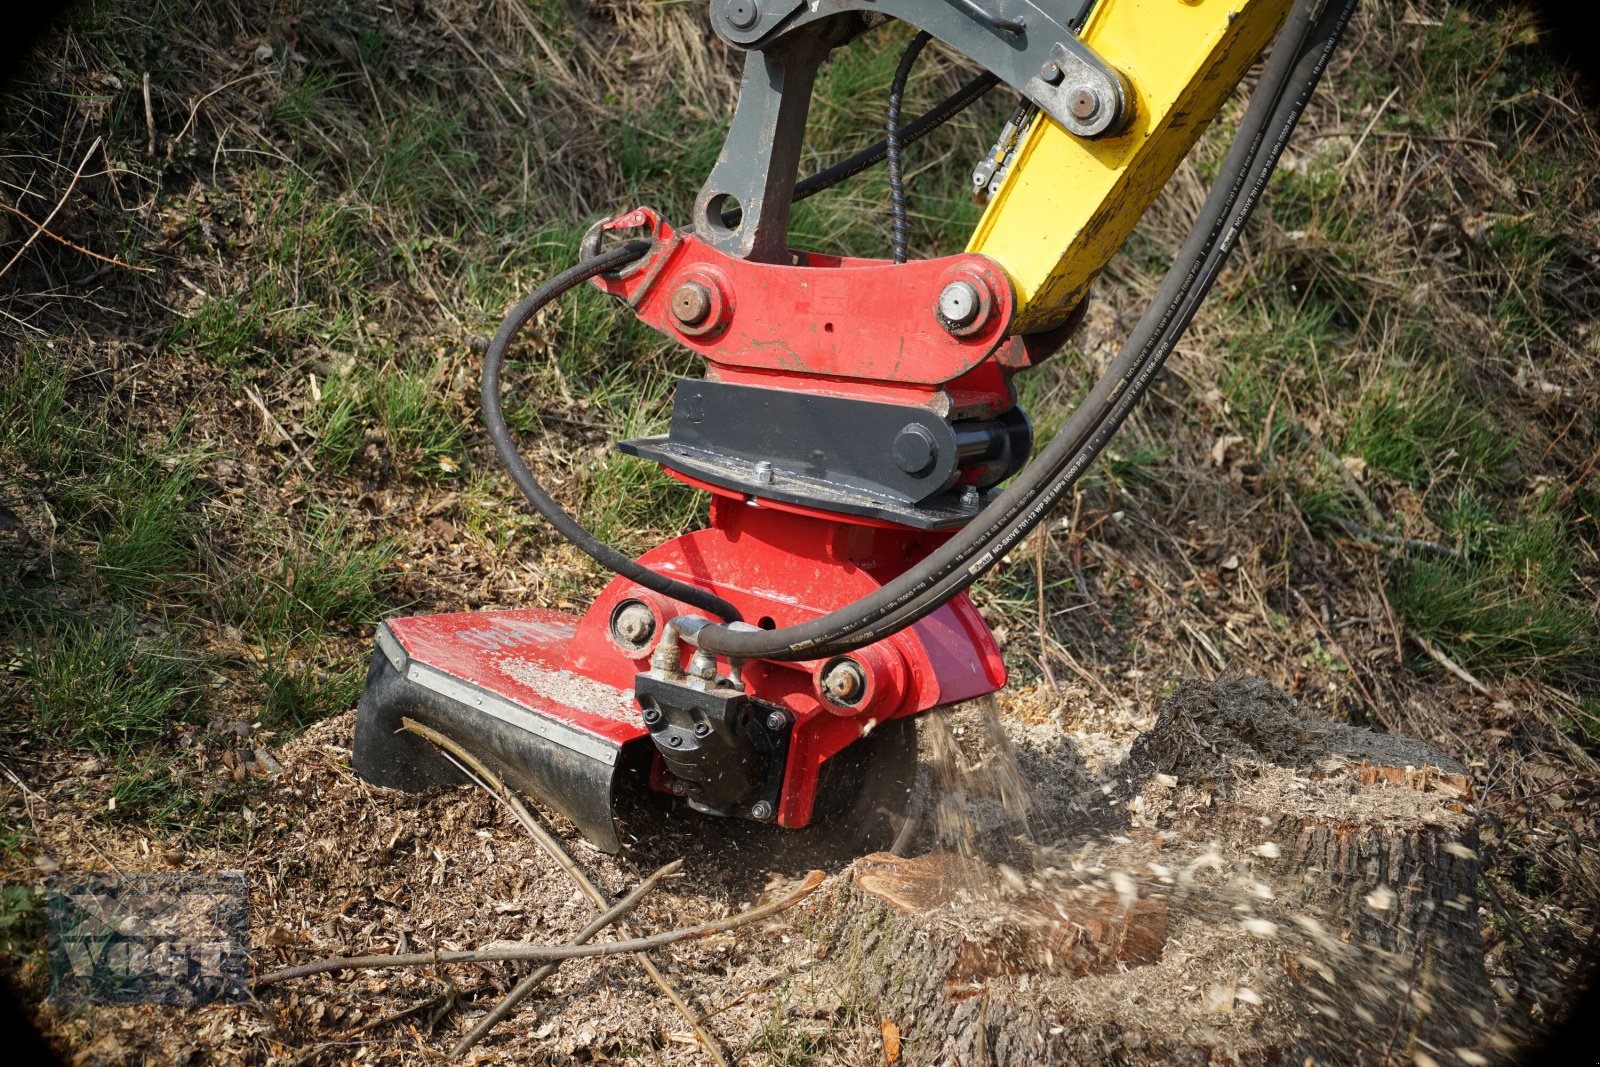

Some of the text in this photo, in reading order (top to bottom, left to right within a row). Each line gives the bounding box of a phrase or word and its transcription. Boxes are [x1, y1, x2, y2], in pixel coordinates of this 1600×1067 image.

[1233, 197, 1254, 227] NO-SKIVE
[1259, 166, 1269, 179] WP
[1124, 347, 1149, 378] NO-SKIVE
[1157, 317, 1168, 330] WP
[1107, 416, 1116, 425] 19
[1113, 406, 1124, 418] mm
[1120, 393, 1133, 408] (3/4)
[1133, 380, 1142, 390] 4S
[1138, 371, 1149, 382] EN
[991, 527, 1020, 555] NO-SKIVE
[1017, 510, 1037, 531] 701-12
[1033, 501, 1045, 514] WP
[1041, 490, 1055, 505] 35.0
[1052, 478, 1066, 493] MPa
[1062, 464, 1078, 482] (5000
[1074, 452, 1088, 467] PSI)
[954, 553, 964, 562] 19
